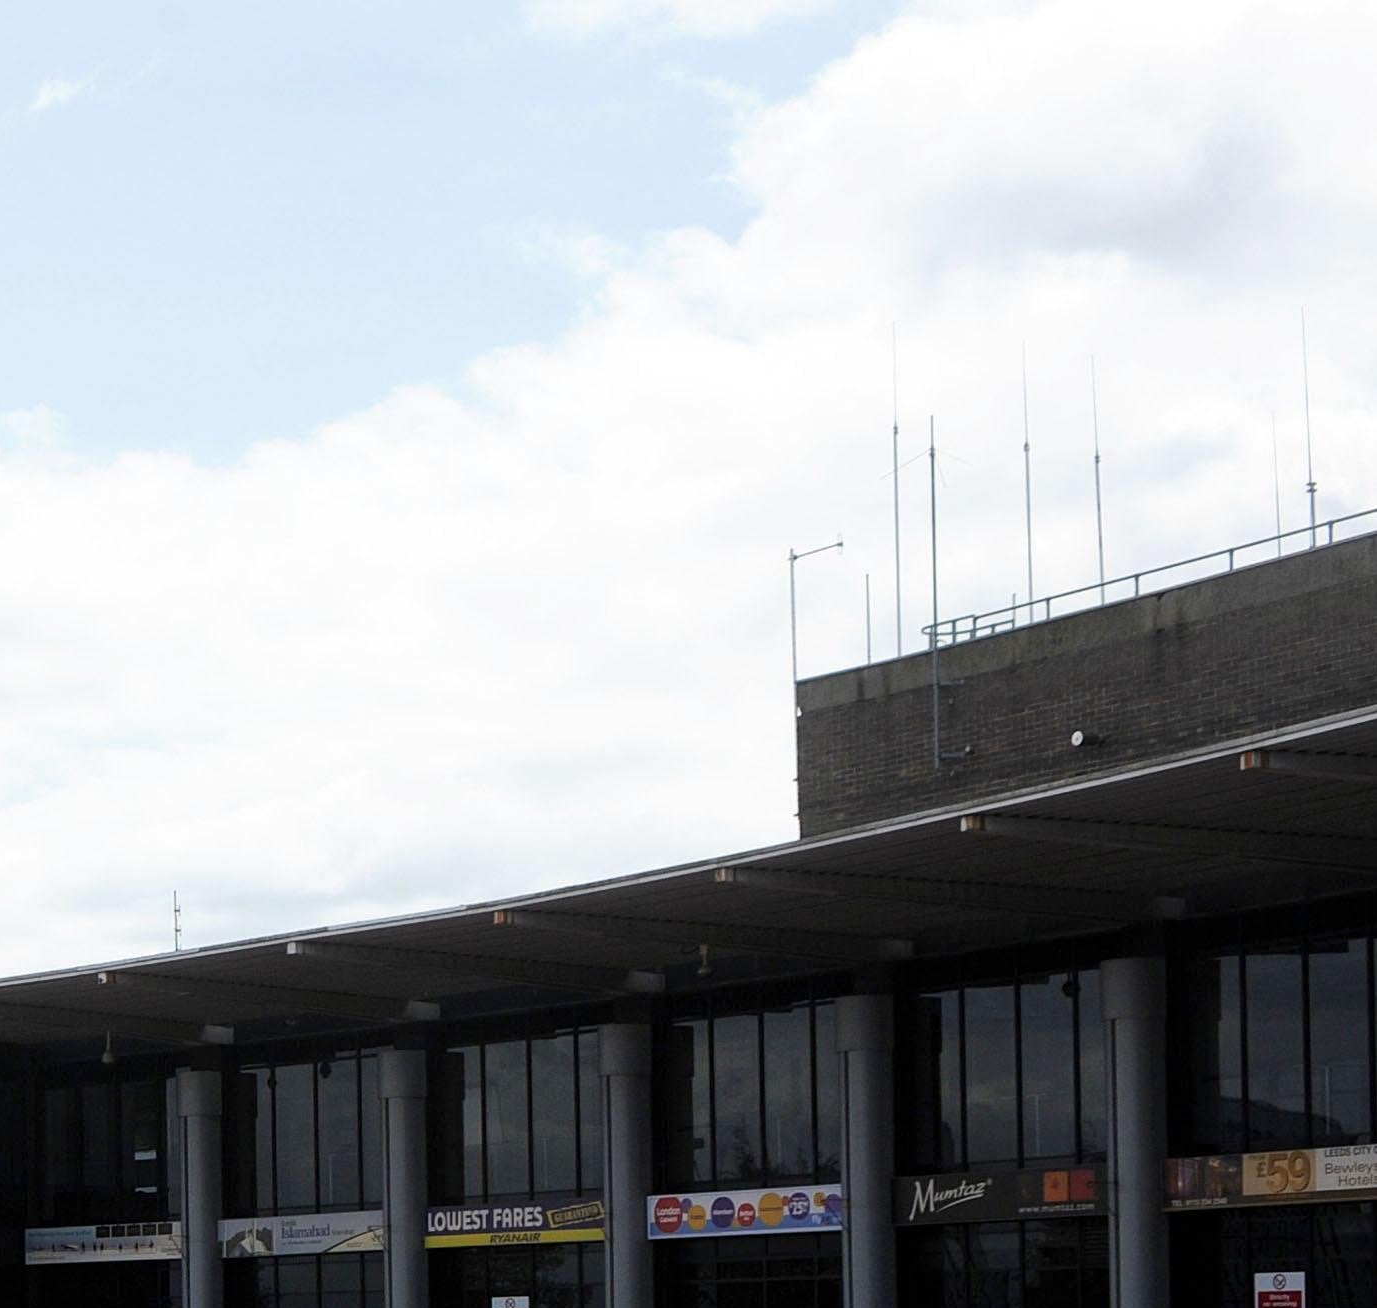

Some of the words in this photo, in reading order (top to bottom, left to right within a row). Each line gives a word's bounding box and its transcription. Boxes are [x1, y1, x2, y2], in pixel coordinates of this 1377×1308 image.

[1325, 1147, 1351, 1158] LEEDS
[427, 1208, 490, 1233] LOWEST
[492, 1205, 543, 1229] FARES
[489, 1232, 541, 1244] RYANAIR
